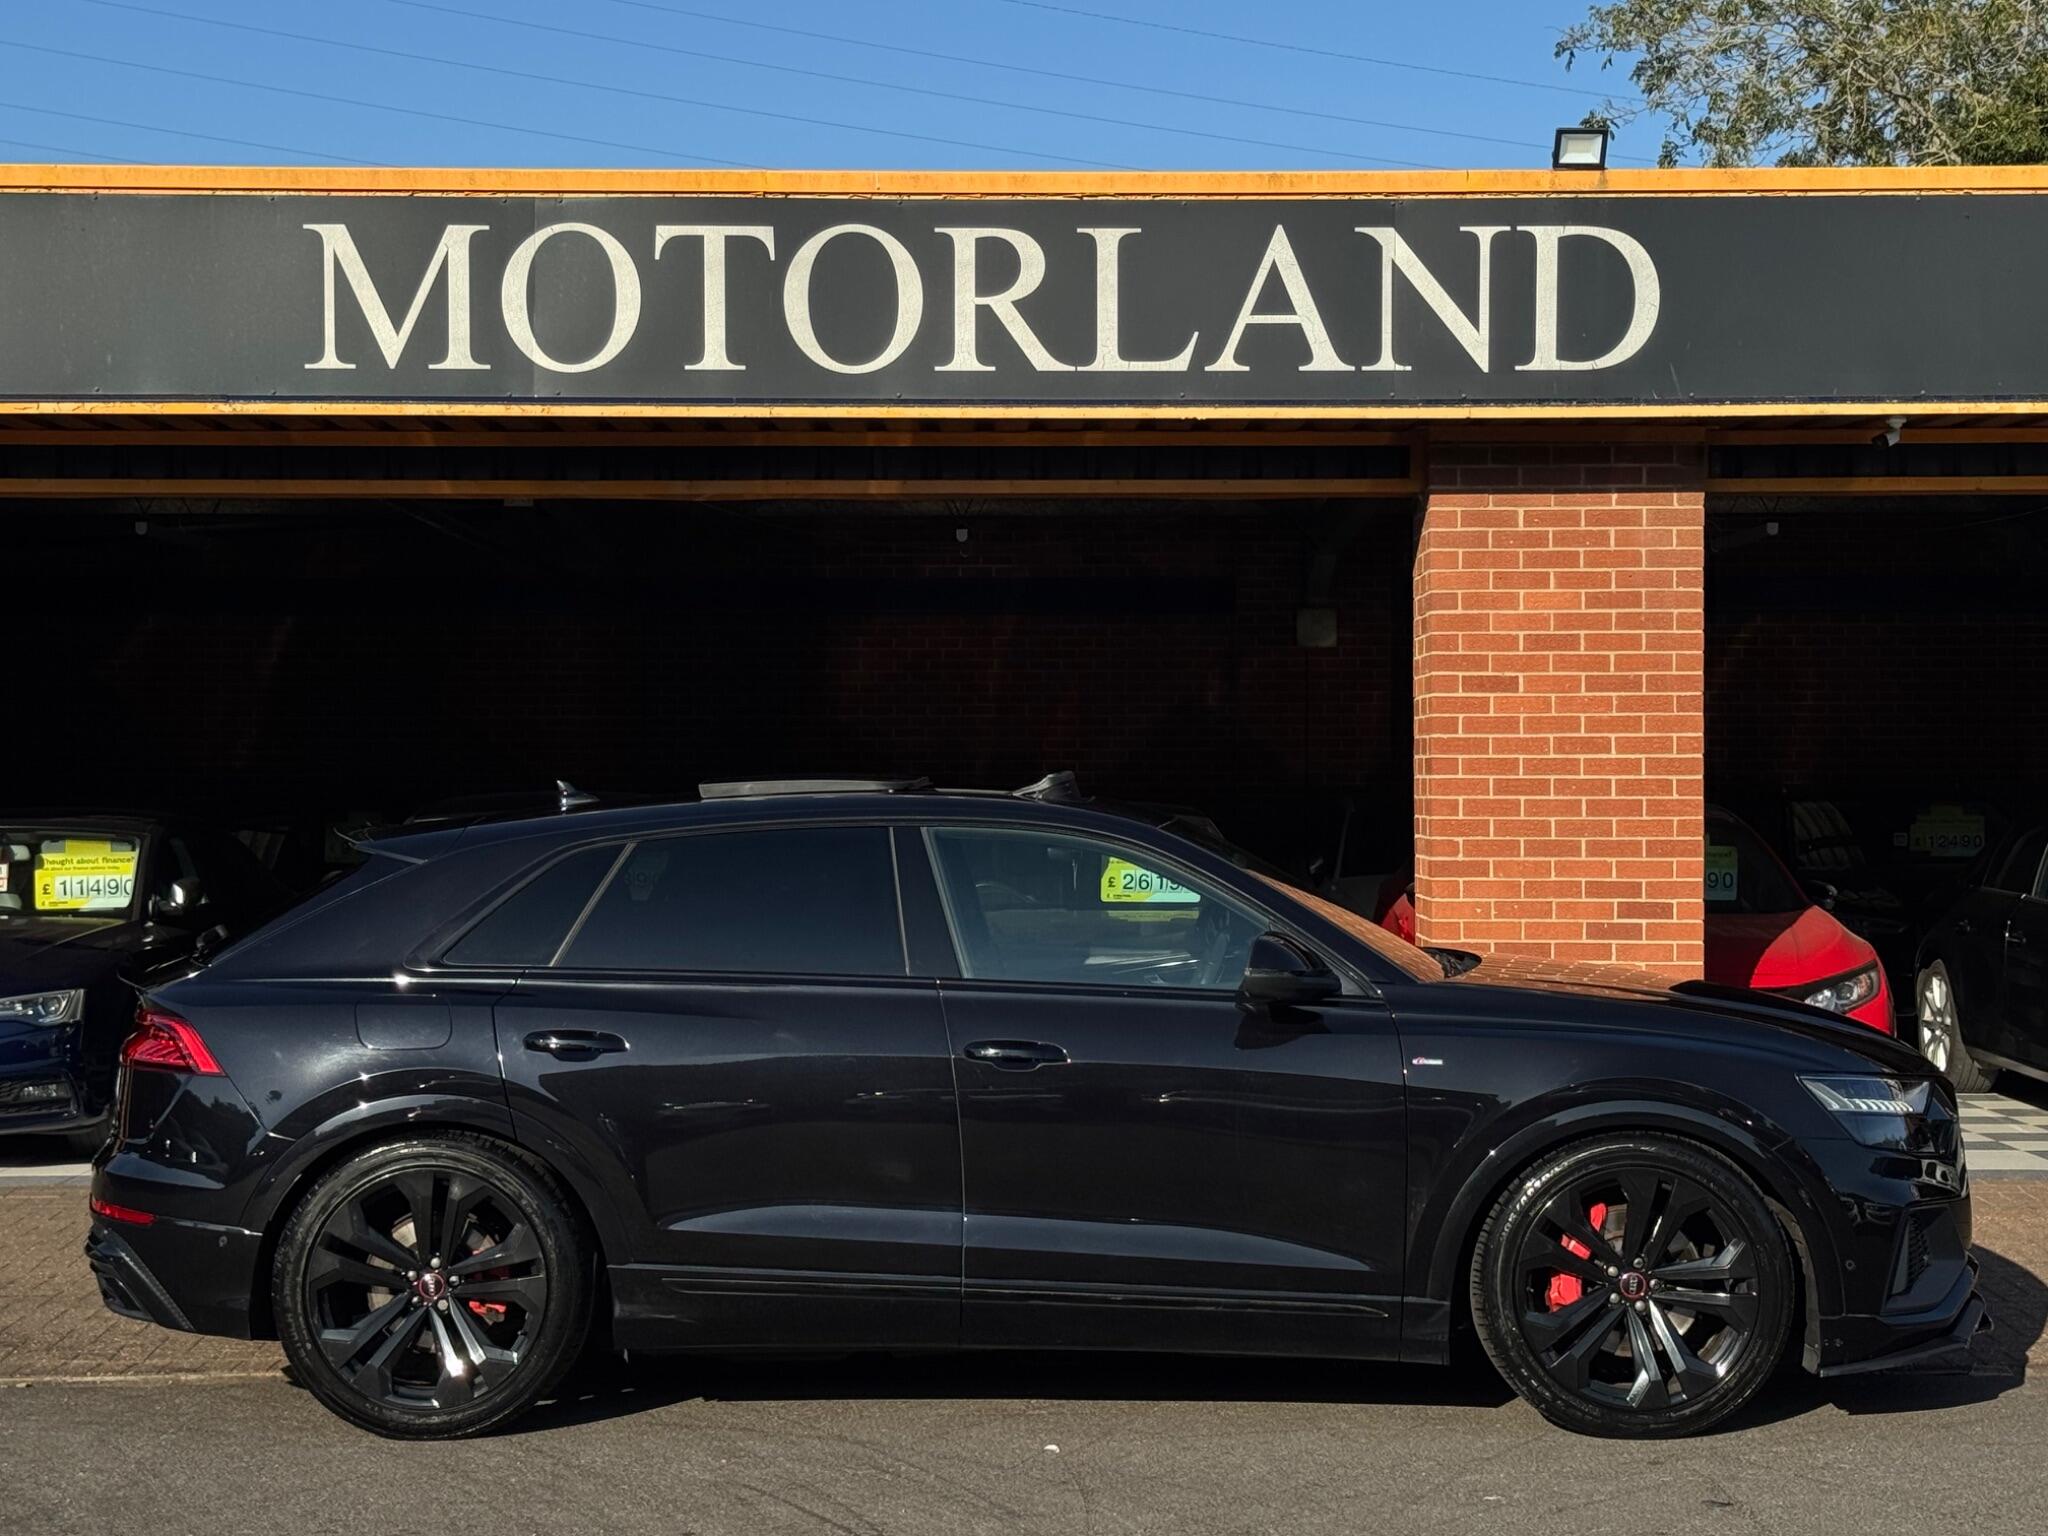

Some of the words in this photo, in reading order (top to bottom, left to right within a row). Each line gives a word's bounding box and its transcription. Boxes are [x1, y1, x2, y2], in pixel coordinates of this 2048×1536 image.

[302, 222, 1661, 376] MOTORLAND
[1928, 833, 1983, 849] 12490
[45, 858, 74, 866] hought
[76, 857, 101, 865] about
[1108, 876, 1117, 888] £
[1707, 871, 1734, 889] 90
[42, 883, 52, 895] £
